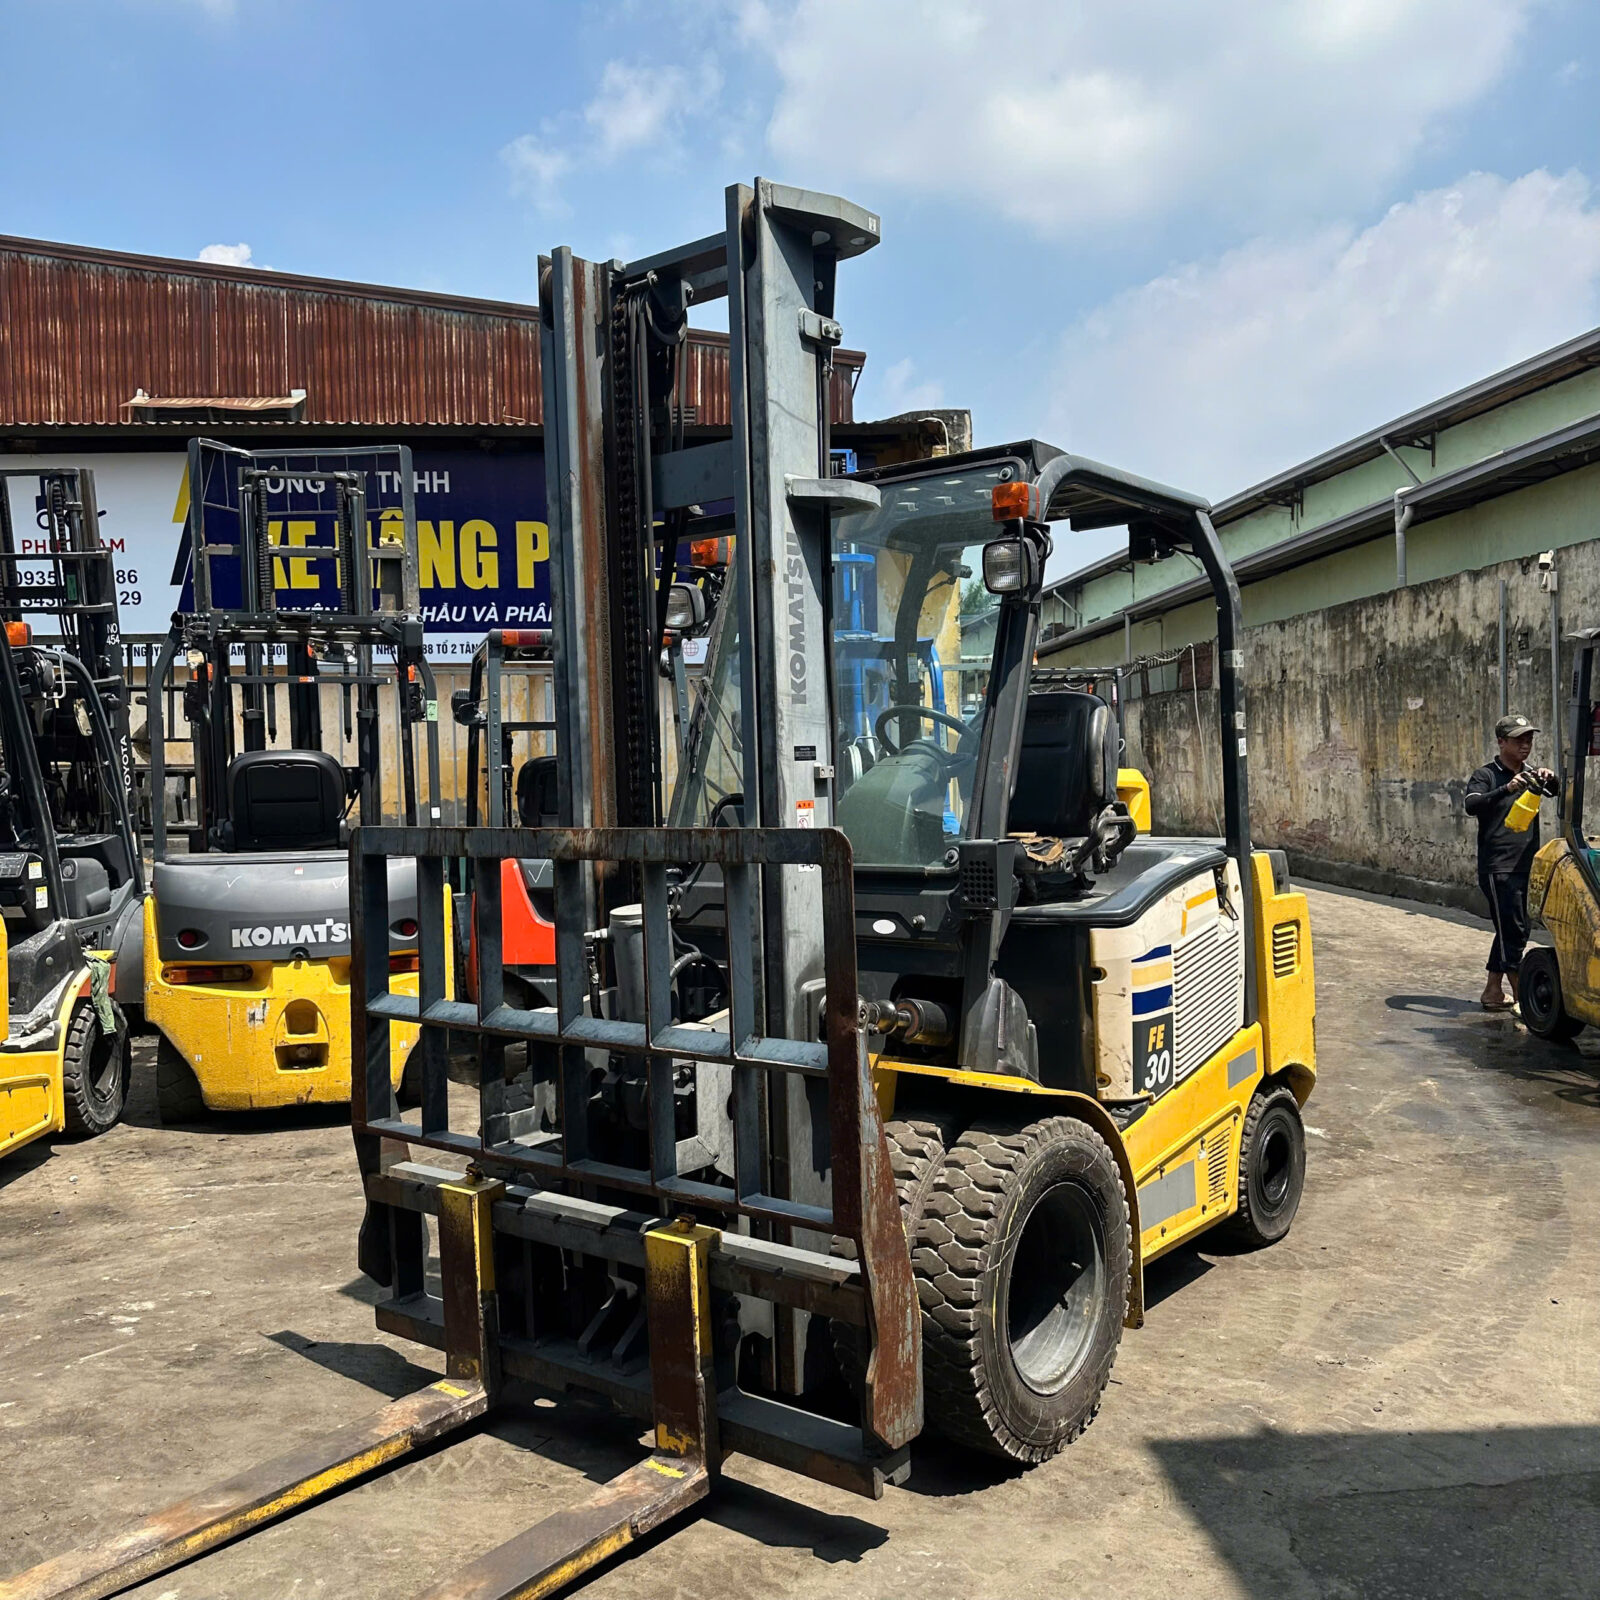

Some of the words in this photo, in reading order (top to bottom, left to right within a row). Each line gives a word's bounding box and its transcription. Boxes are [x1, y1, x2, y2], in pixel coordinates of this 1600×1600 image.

[264, 465, 326, 494] ÔNG
[420, 602, 467, 623] HẨU
[473, 601, 499, 623] VÀ
[505, 602, 552, 623] PHÂ
[783, 531, 807, 705] KOMATSU
[106, 635, 120, 645] 454
[450, 643, 457, 654] 2
[120, 735, 132, 795] TOYOTA
[231, 918, 352, 948] KOMATS
[1148, 1023, 1165, 1053] FE
[1144, 1049, 1170, 1089] 30
